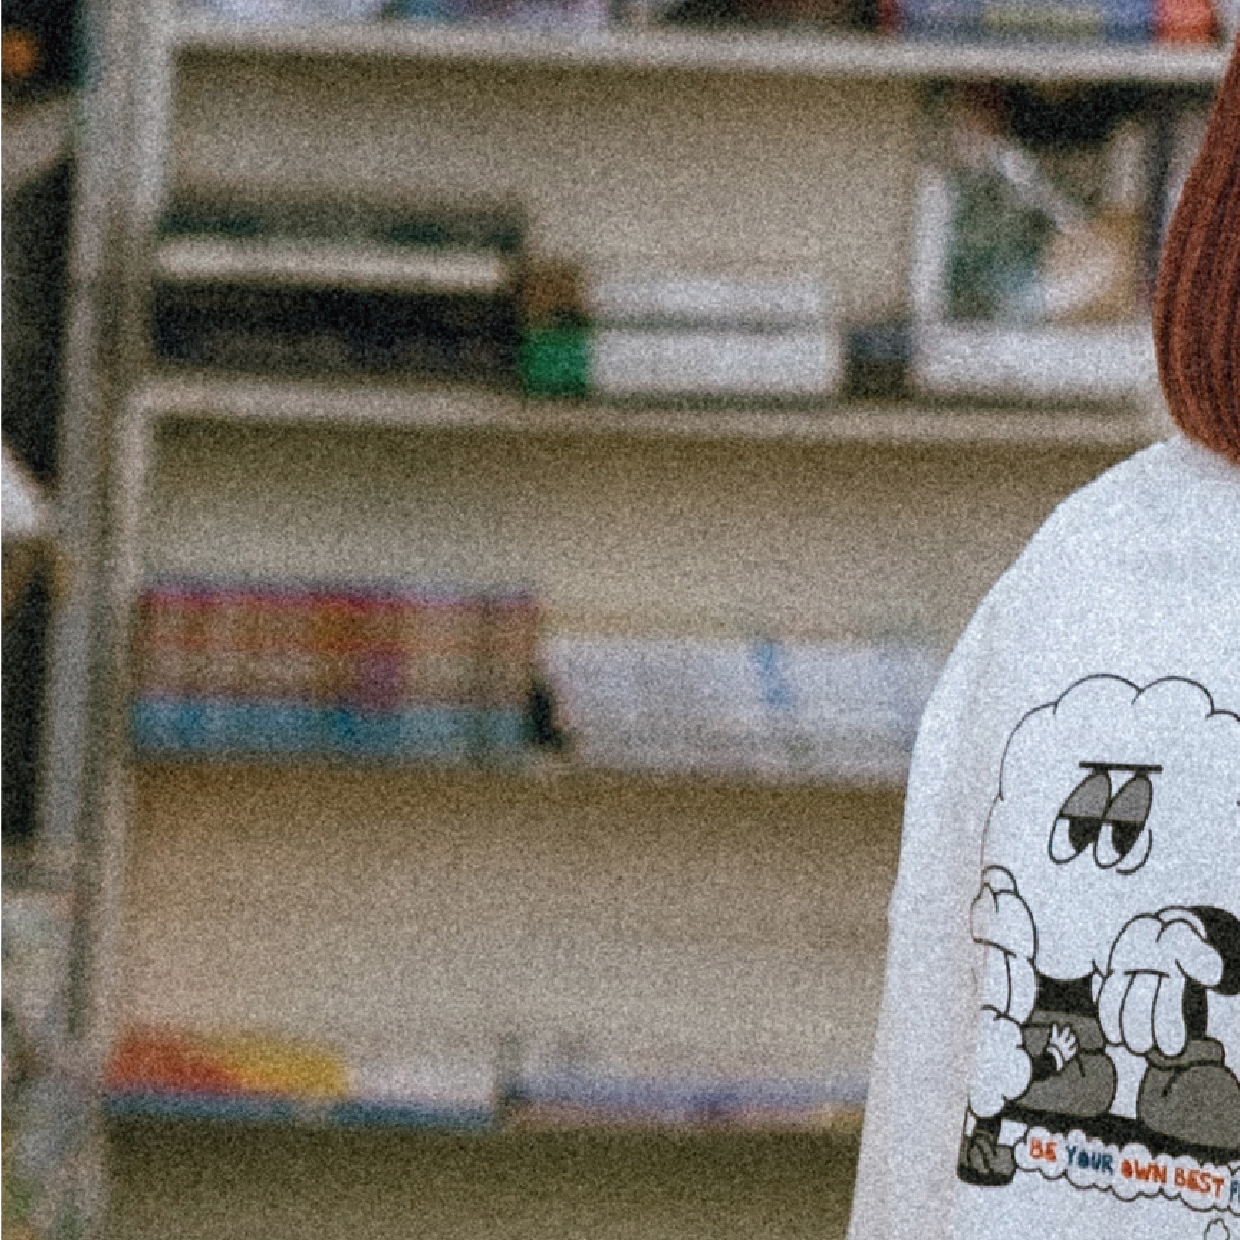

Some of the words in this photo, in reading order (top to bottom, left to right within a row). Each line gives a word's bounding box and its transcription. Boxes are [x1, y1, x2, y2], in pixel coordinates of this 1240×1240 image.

[1029, 1137, 1057, 1162] BE
[1066, 1145, 1114, 1174] YOUR
[1121, 1160, 1167, 1184] OWN
[1174, 1167, 1225, 1199] BEST
